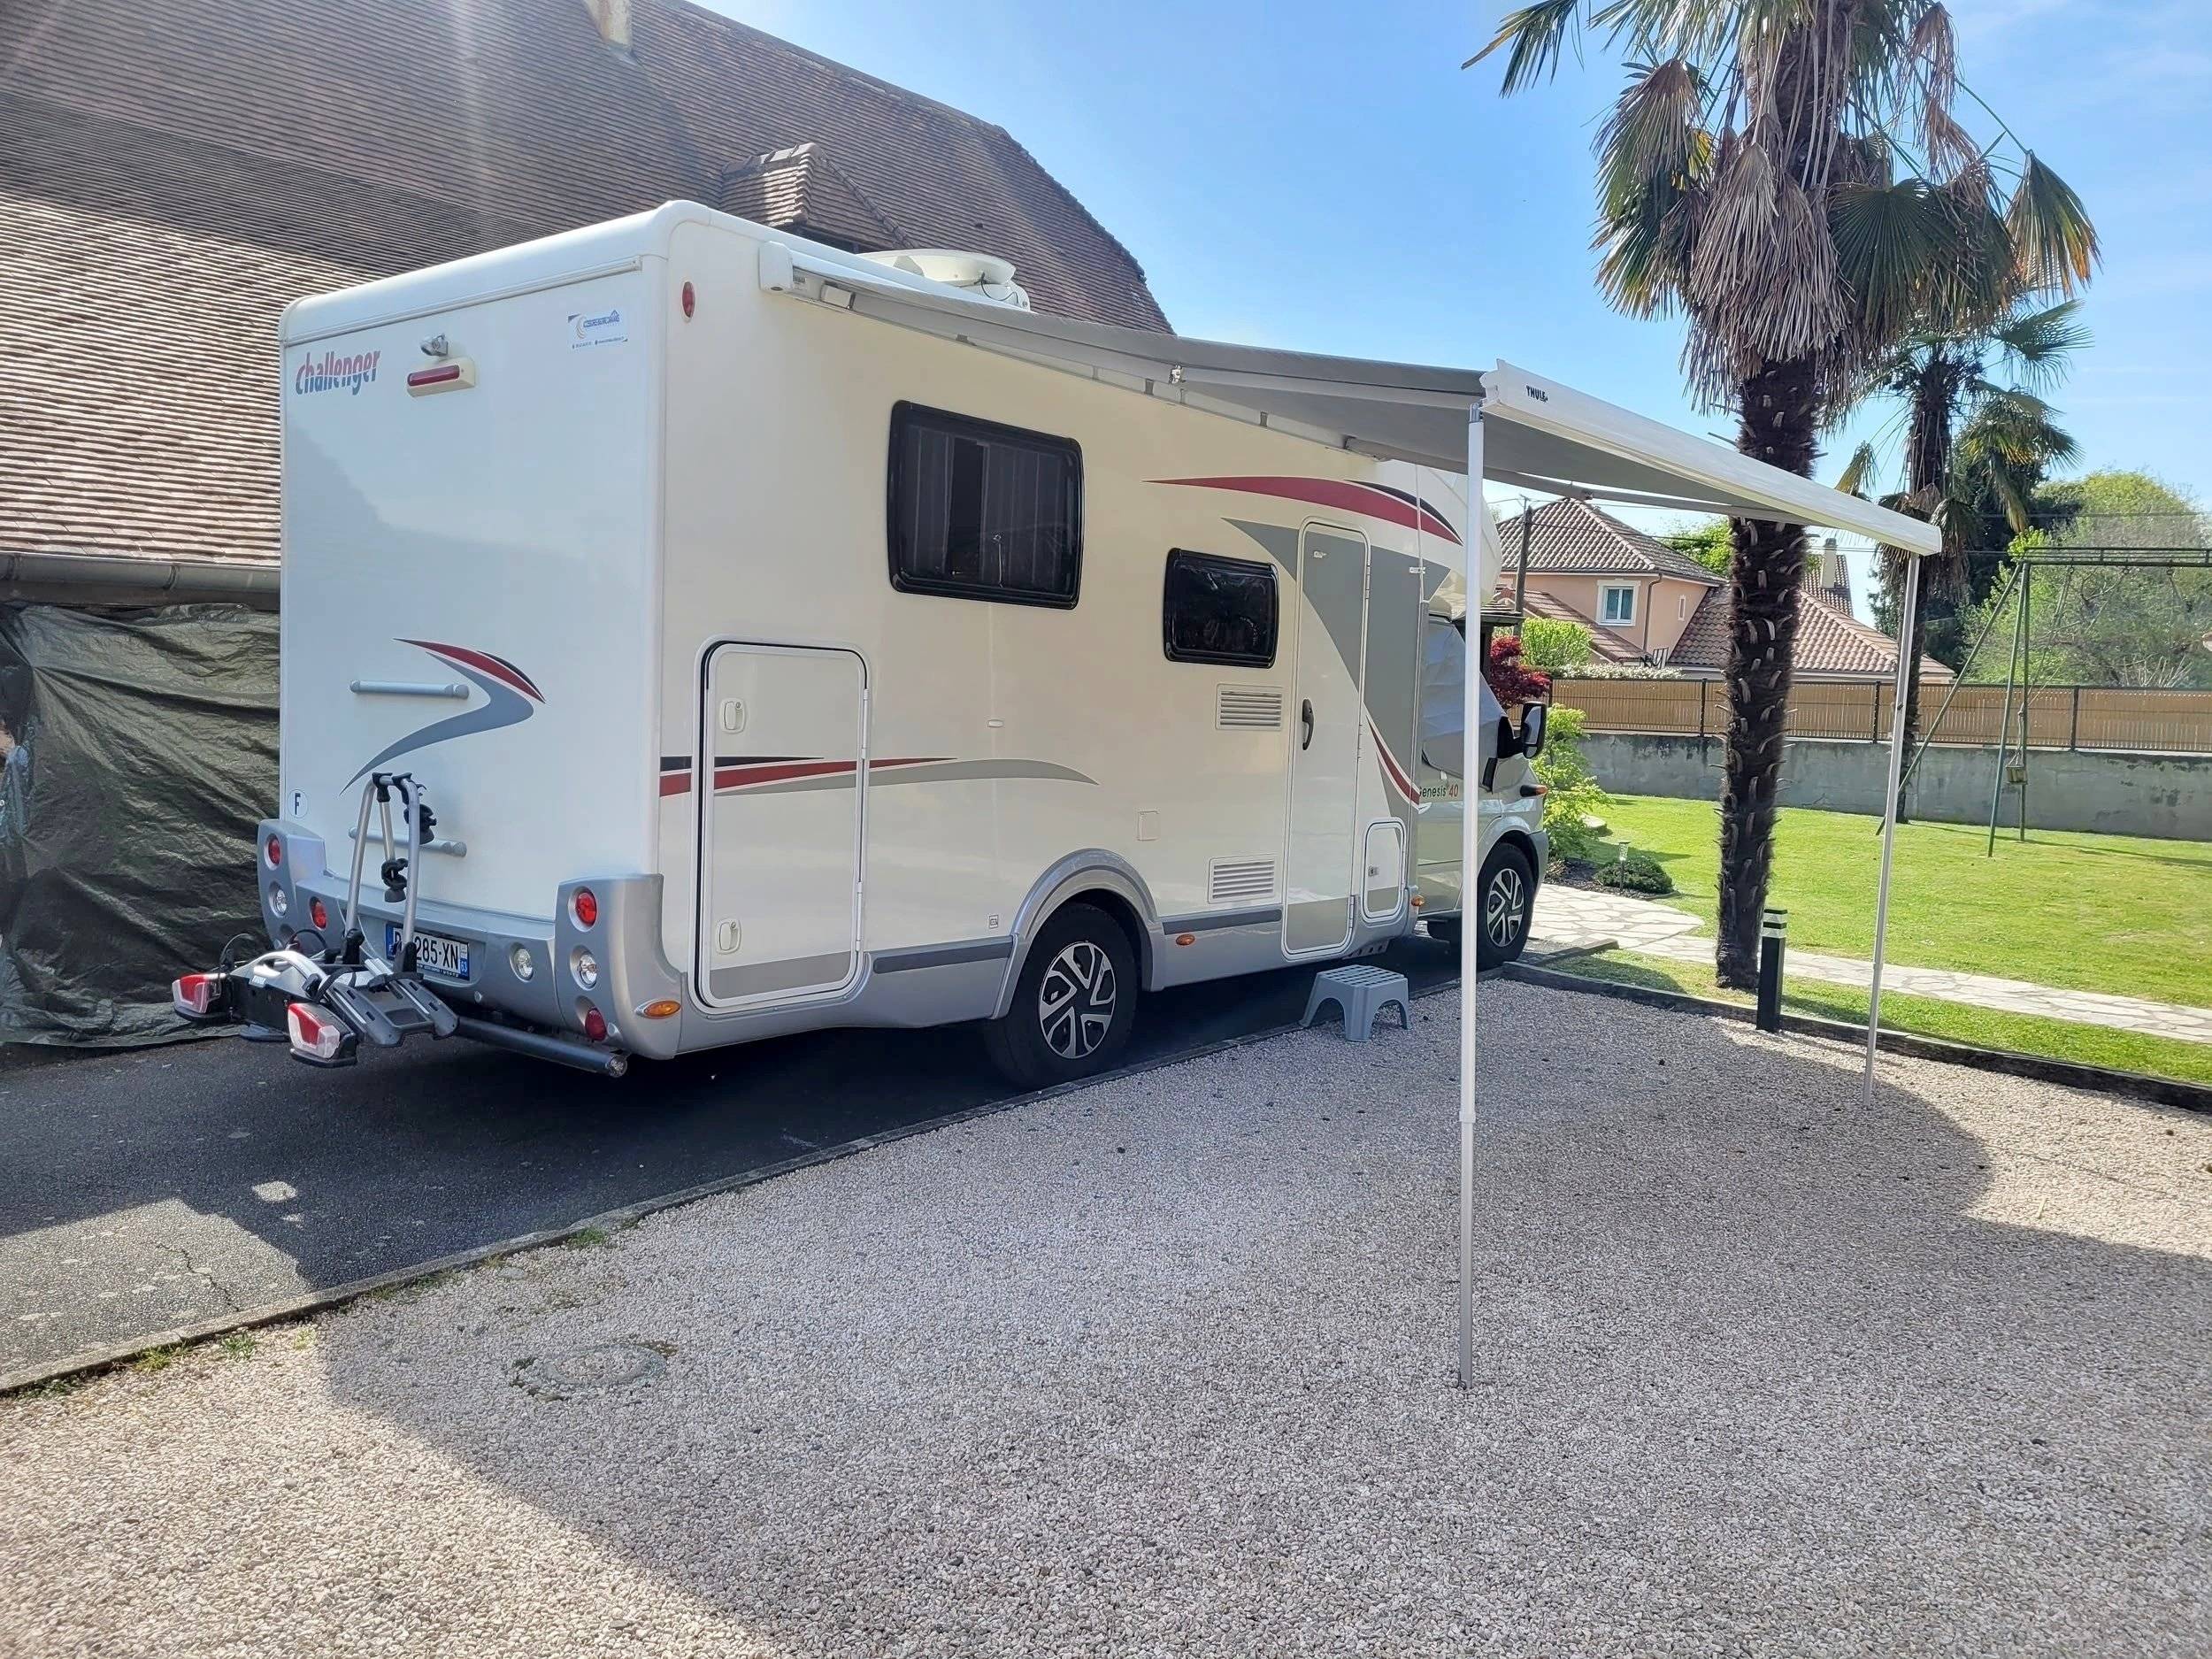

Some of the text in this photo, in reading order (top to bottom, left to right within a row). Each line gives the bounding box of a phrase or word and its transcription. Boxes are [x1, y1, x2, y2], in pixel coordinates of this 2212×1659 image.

[1526, 385, 1546, 401] THULE
[1448, 784, 1459, 797] 40
[295, 793, 301, 815] F
